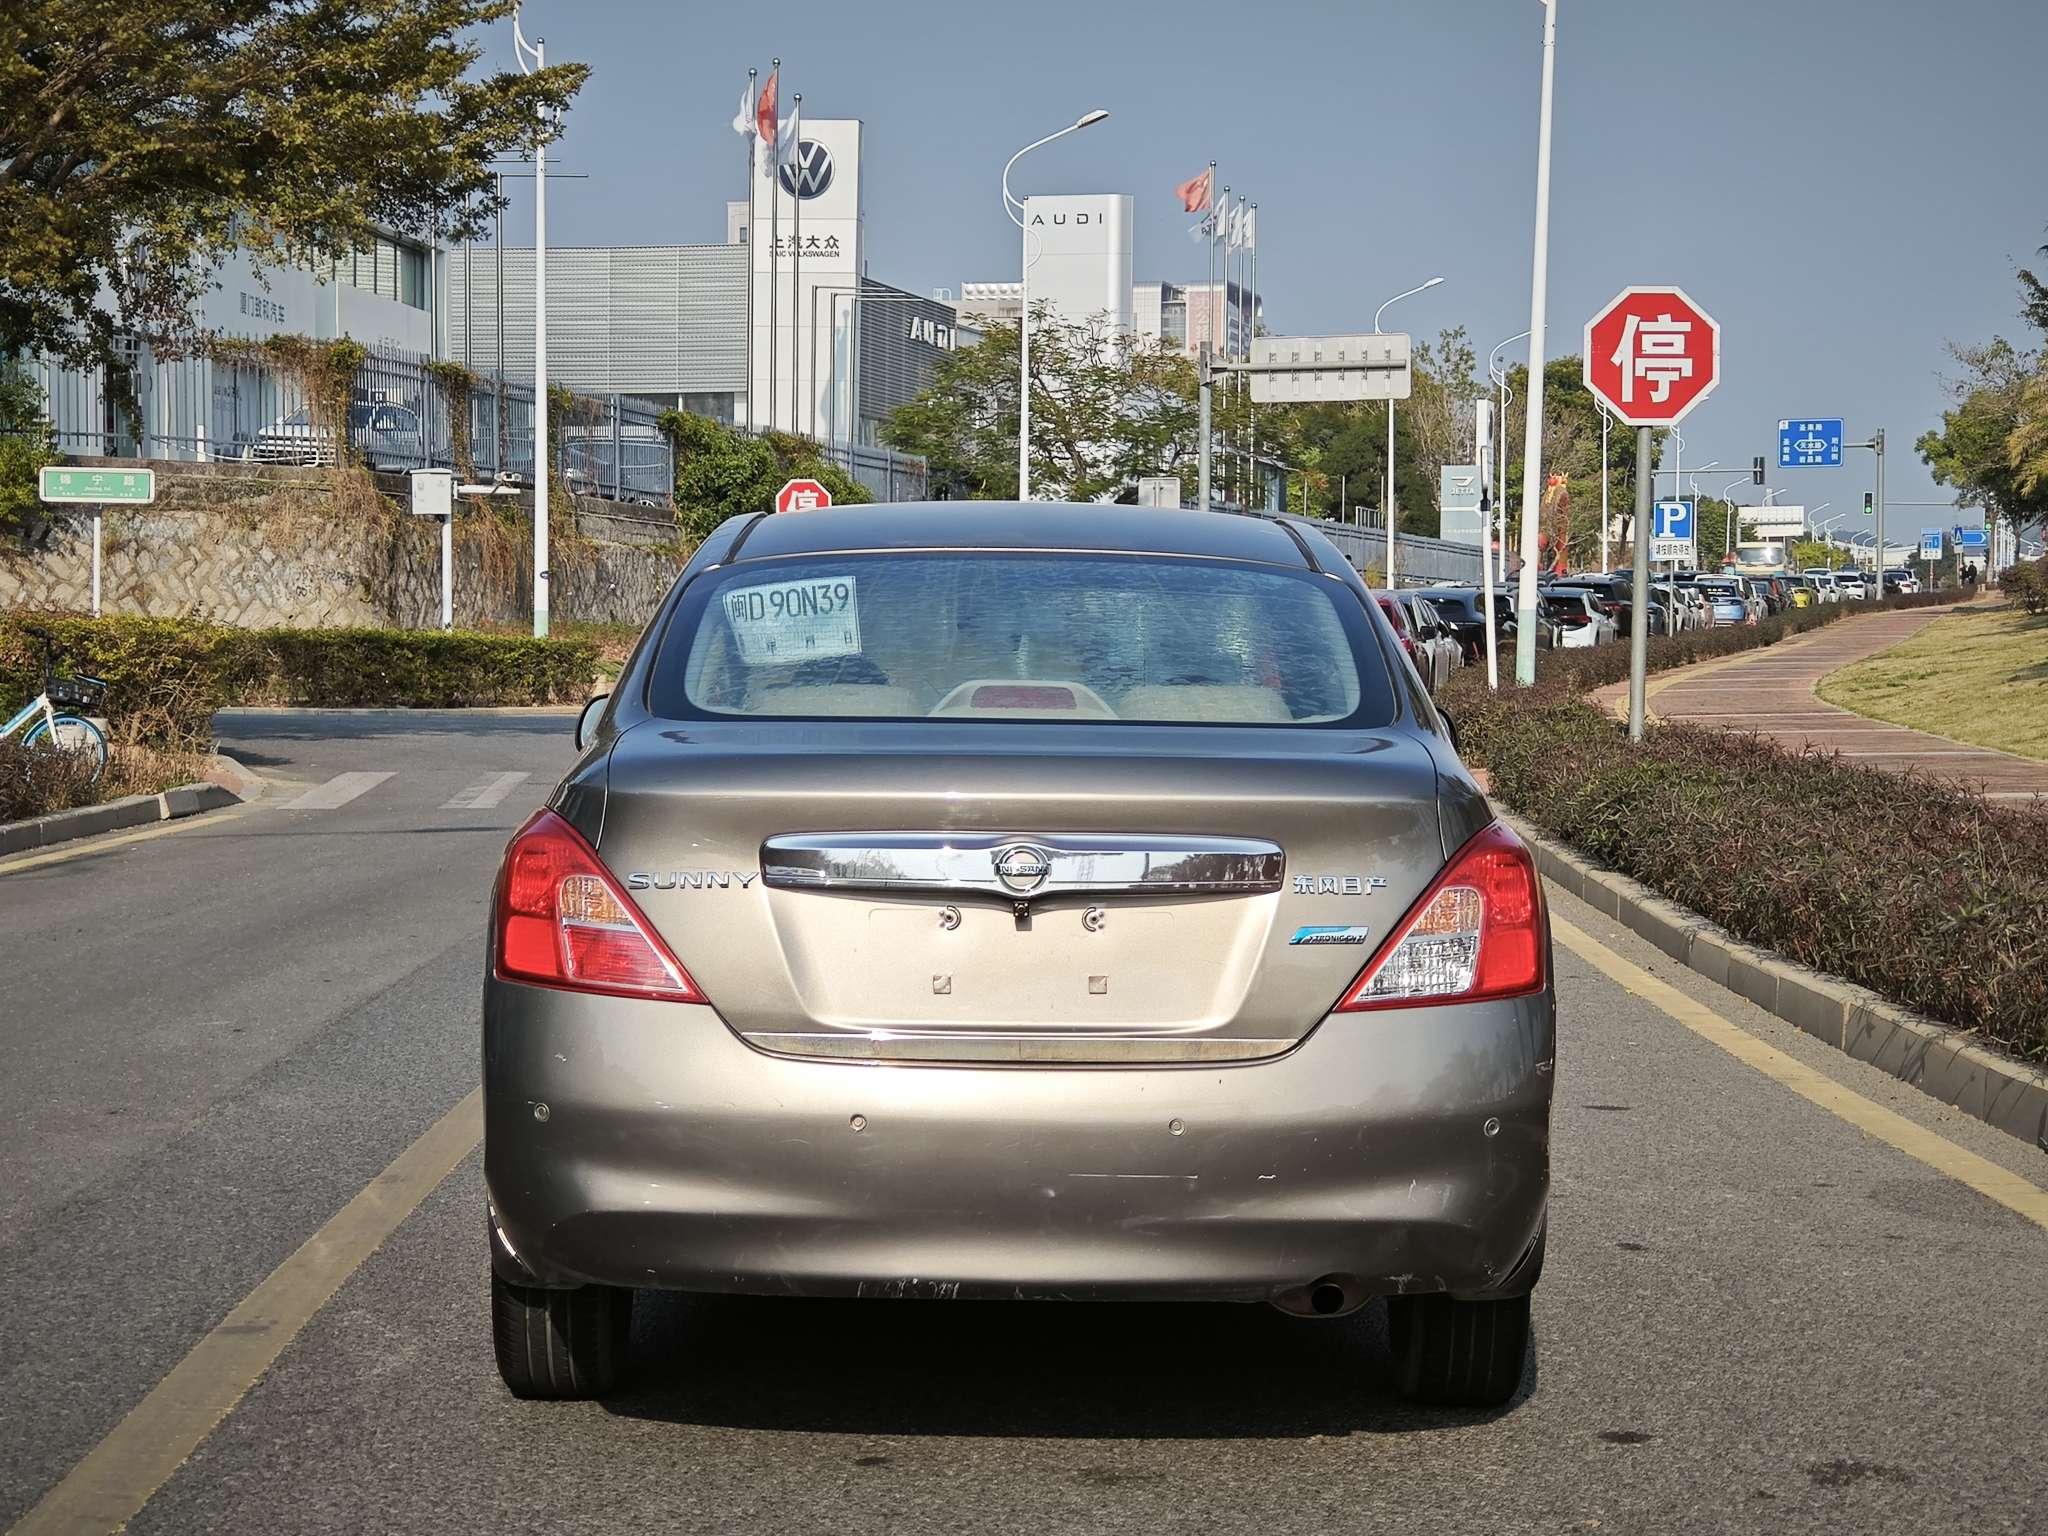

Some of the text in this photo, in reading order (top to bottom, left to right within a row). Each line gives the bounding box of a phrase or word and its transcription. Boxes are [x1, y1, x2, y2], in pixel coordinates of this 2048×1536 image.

[1031, 213, 1103, 226] AUDI
[768, 235, 840, 250] 上汽大众
[1610, 313, 1693, 403] 停
[1659, 503, 1687, 538] P
[1000, 865, 1044, 874] NISAN
[627, 871, 760, 890] SUNNY
[1293, 875, 1387, 896] 东风日产
